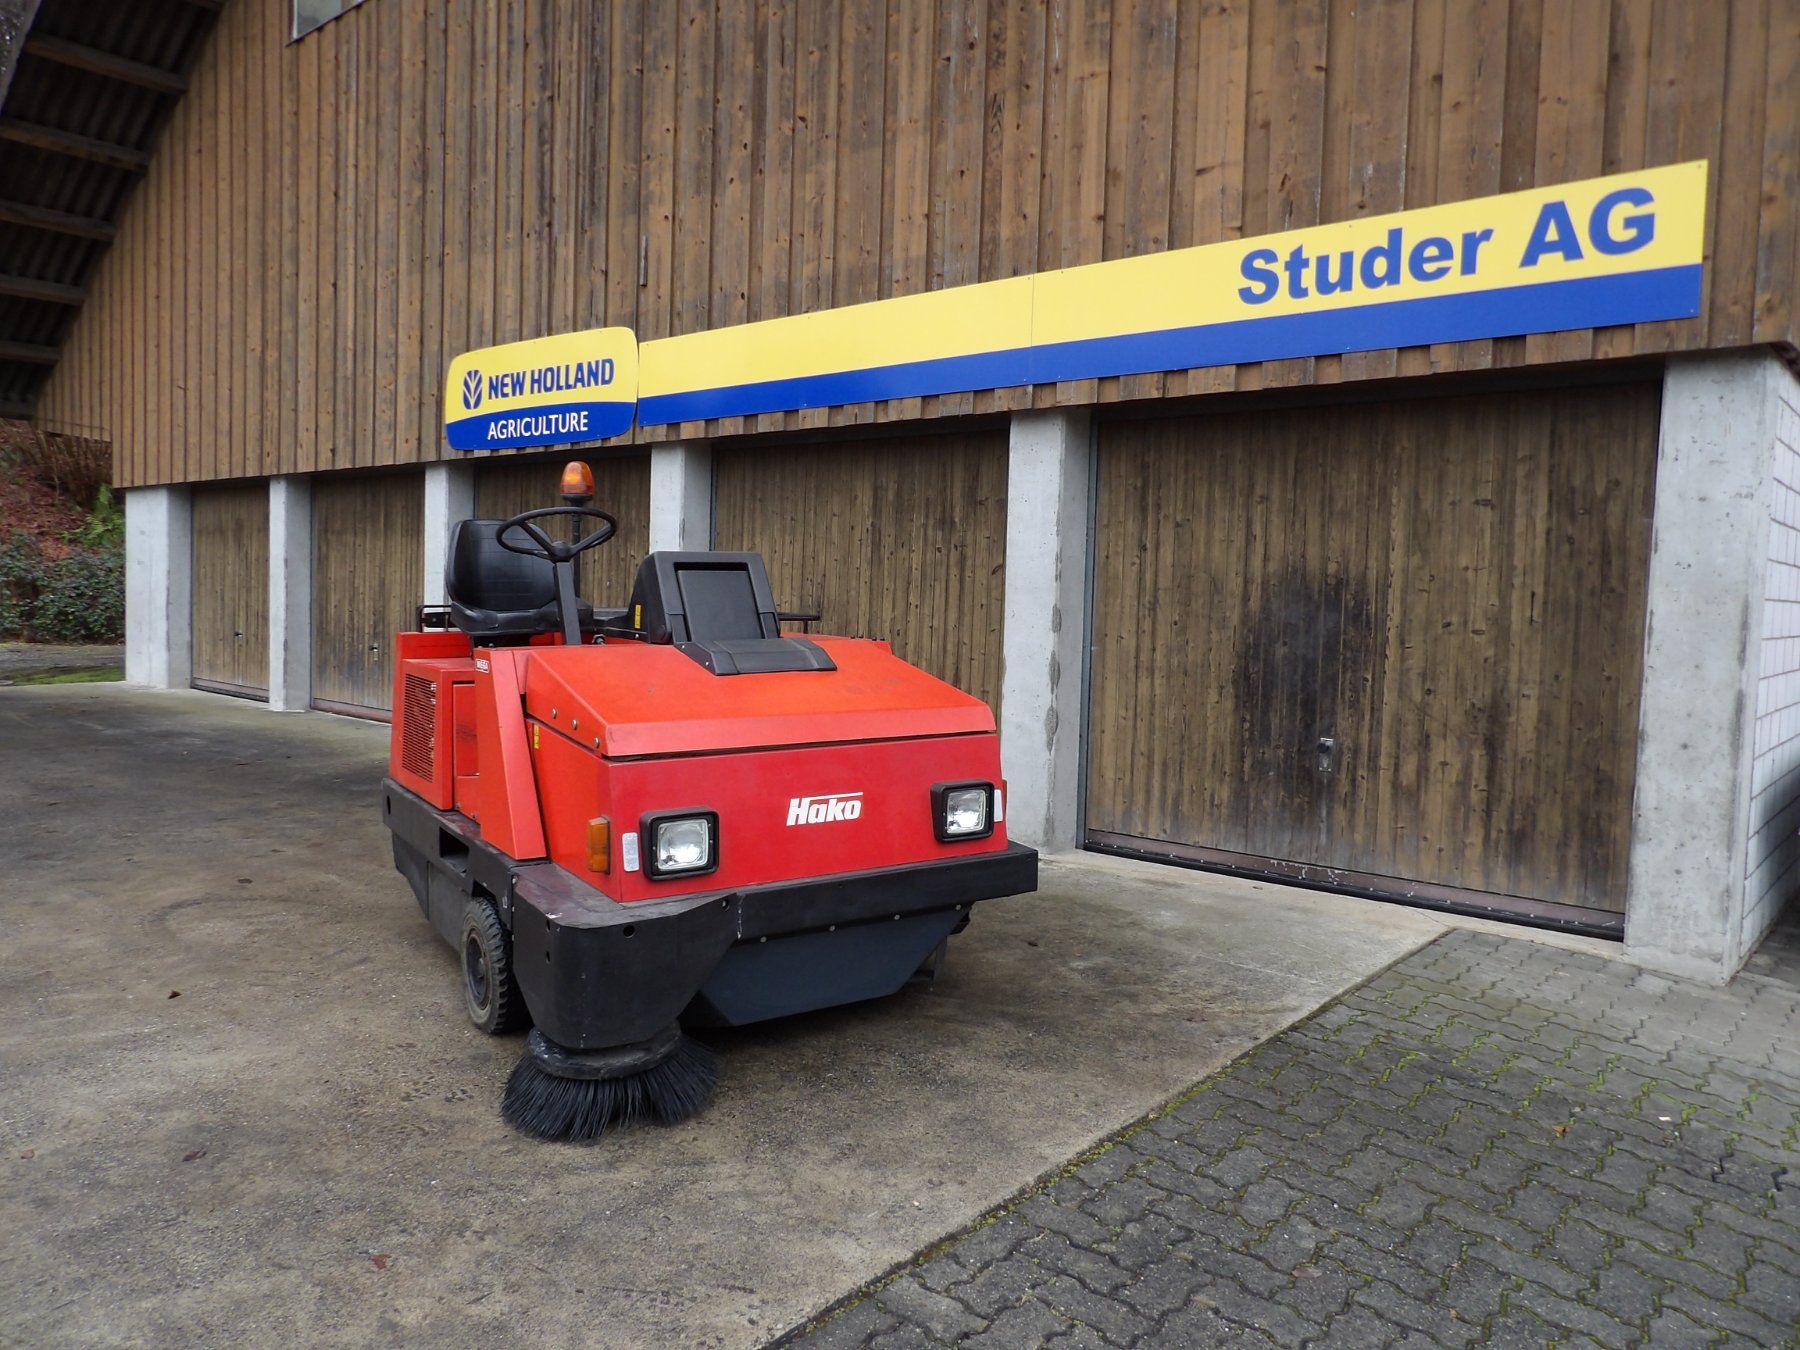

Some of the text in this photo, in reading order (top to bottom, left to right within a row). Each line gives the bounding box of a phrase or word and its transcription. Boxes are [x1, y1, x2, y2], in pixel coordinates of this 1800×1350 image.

[1238, 187, 1656, 305] Studer AG
[488, 358, 615, 400] NEW HOLLAND
[487, 411, 589, 440] AGRICULTURE
[786, 792, 864, 826] Hako
